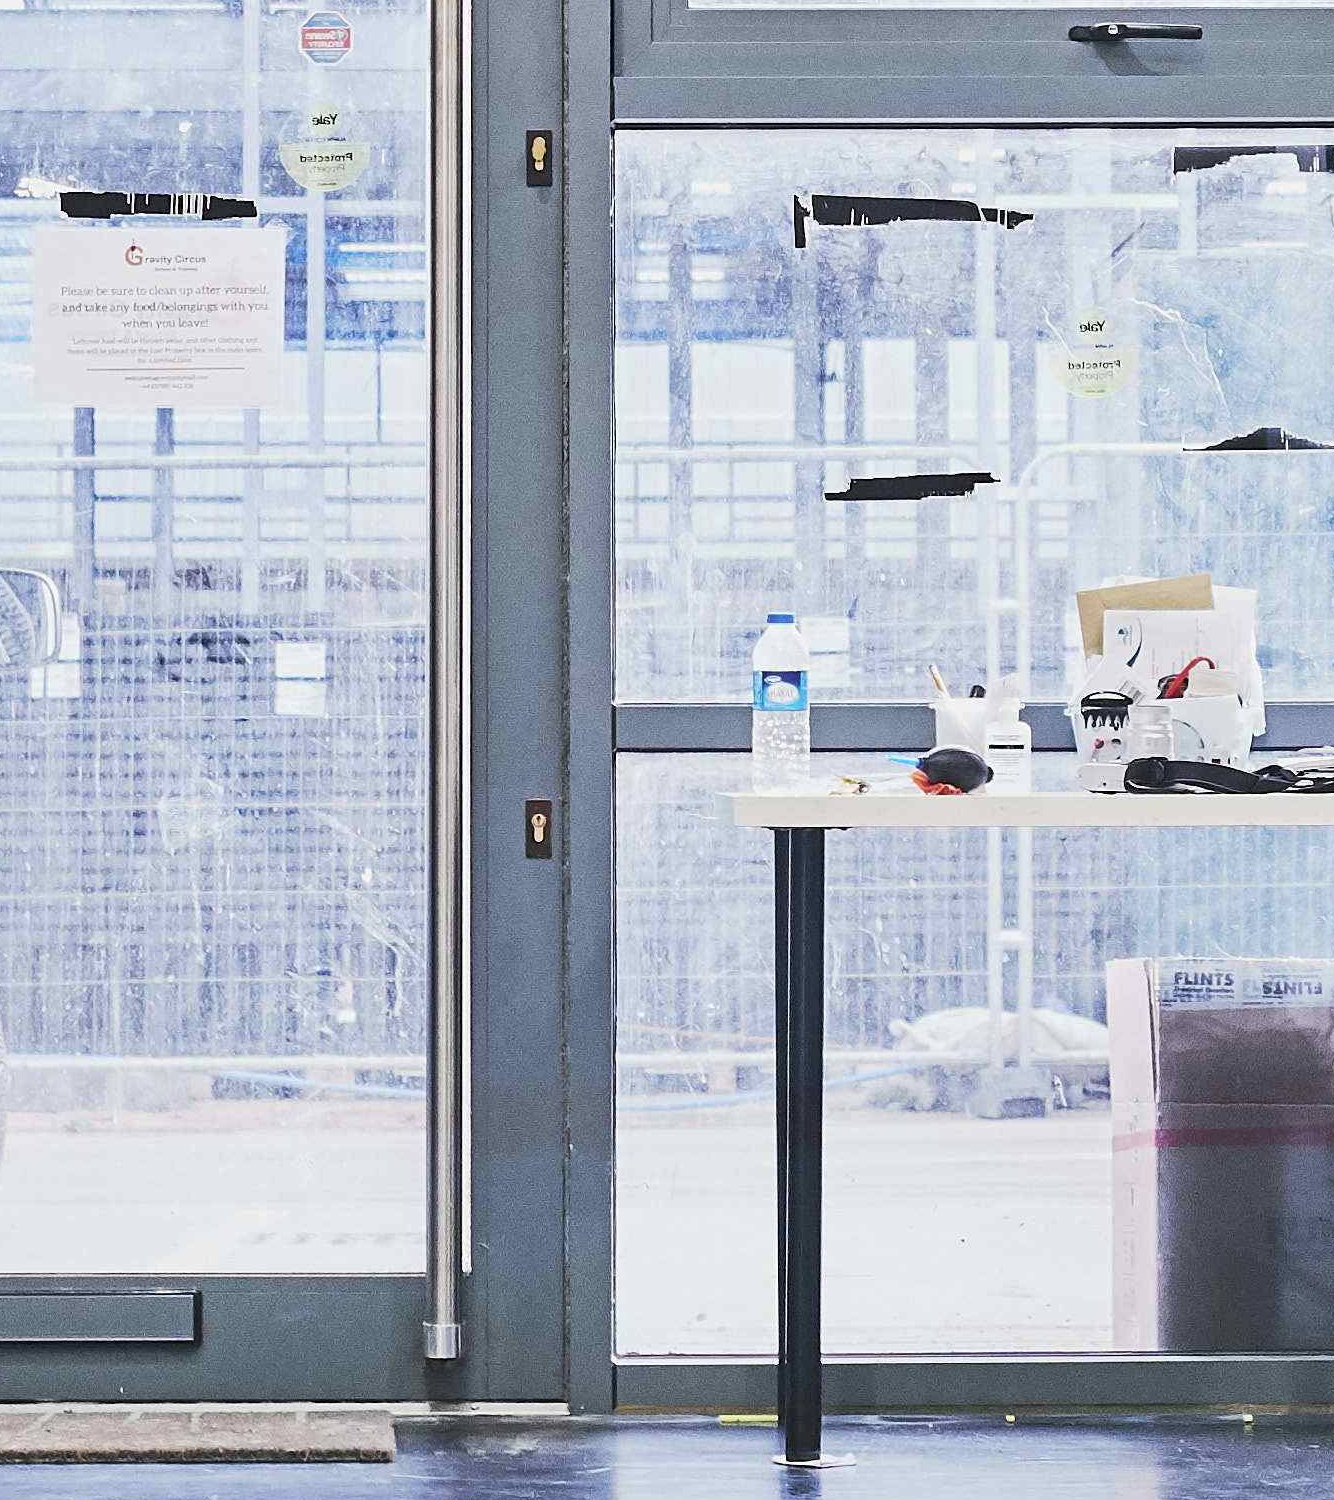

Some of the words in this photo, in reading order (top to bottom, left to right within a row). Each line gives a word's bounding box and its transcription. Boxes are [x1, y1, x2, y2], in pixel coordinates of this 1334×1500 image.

[125, 244, 171, 265] Gravity
[175, 254, 207, 264] Circus
[61, 287, 93, 296] Please
[96, 287, 108, 296] be
[136, 288, 146, 296] to
[149, 287, 177, 296] clean
[180, 289, 193, 298] up
[196, 287, 220, 295] after
[62, 303, 82, 312] and
[85, 303, 107, 312] take
[110, 305, 129, 314] any
[133, 302, 217, 314] food/belongings
[221, 302, 245, 311] with
[248, 304, 268, 314] you
[123, 319, 153, 328] when
[156, 321, 175, 330] you
[178, 319, 209, 328] leave!
[1174, 972, 1235, 986] FLINTS
[1262, 981, 1323, 994] FLINTS
